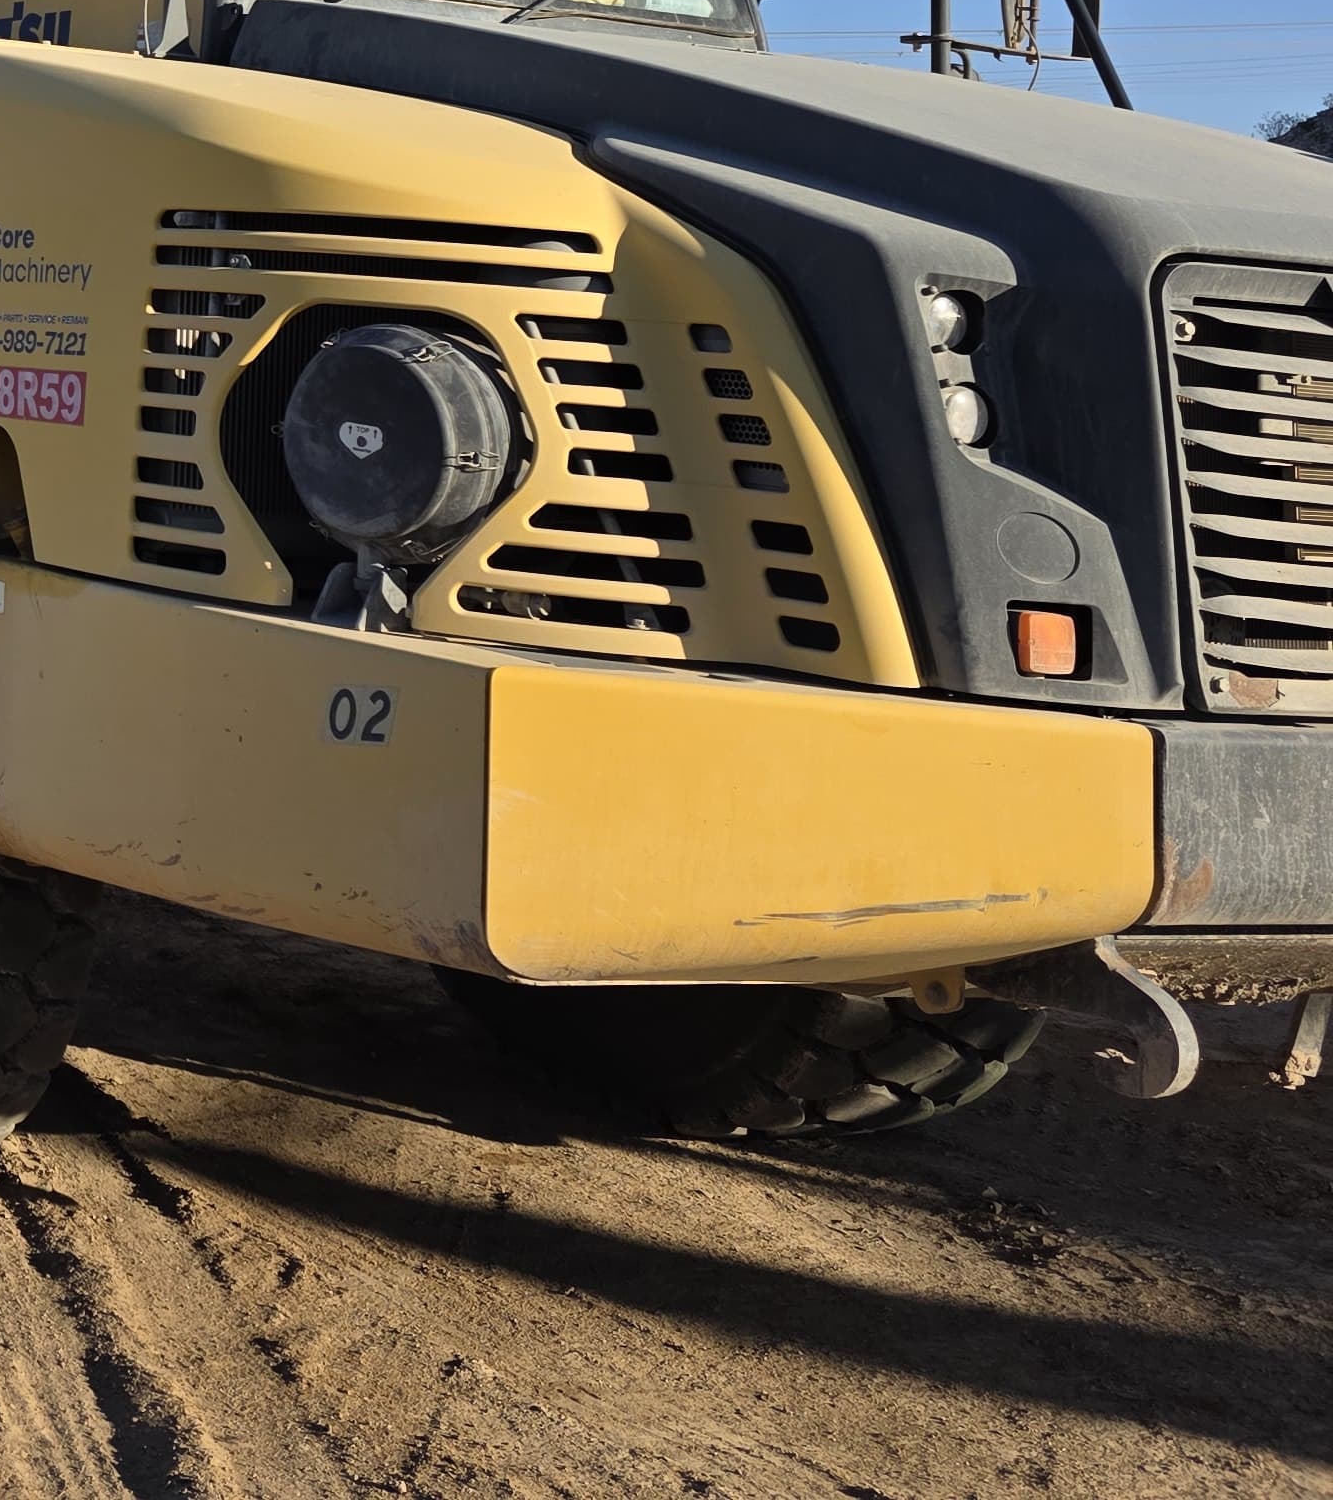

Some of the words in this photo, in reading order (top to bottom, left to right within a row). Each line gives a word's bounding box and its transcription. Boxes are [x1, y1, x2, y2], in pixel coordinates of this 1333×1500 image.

[3, 314, 22, 323] PARTS
[28, 314, 57, 324] SERVICE
[62, 315, 88, 325] REMAN
[356, 425, 370, 434] TOP
[329, 688, 391, 742] 02
